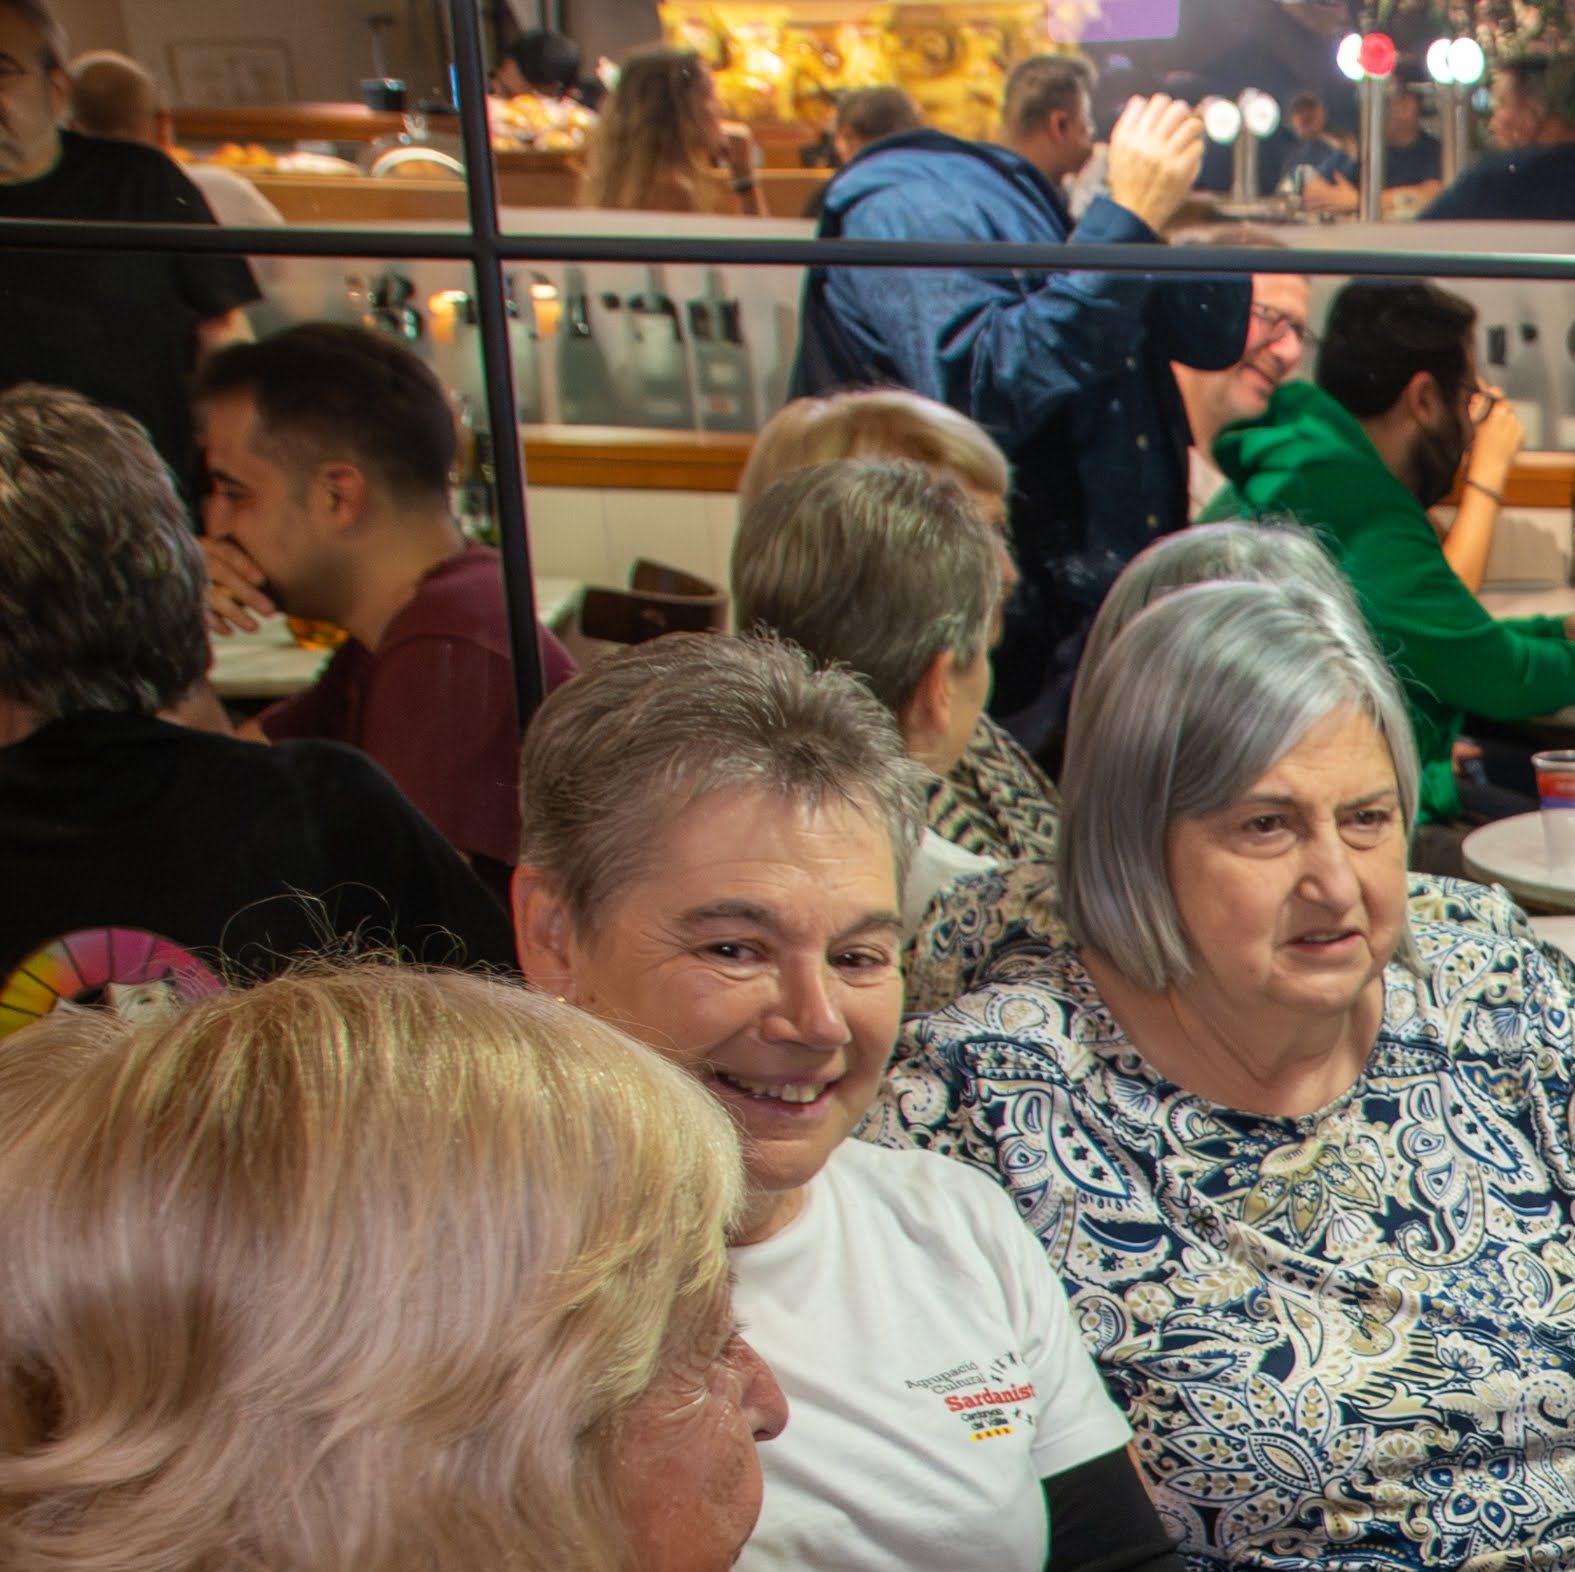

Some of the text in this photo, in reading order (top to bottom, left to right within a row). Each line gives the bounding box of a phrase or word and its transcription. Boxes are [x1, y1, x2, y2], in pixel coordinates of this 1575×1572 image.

[904, 1360, 979, 1389] Agrupació
[932, 1373, 988, 1395] Cultural
[944, 1382, 1036, 1413] Sardanist
